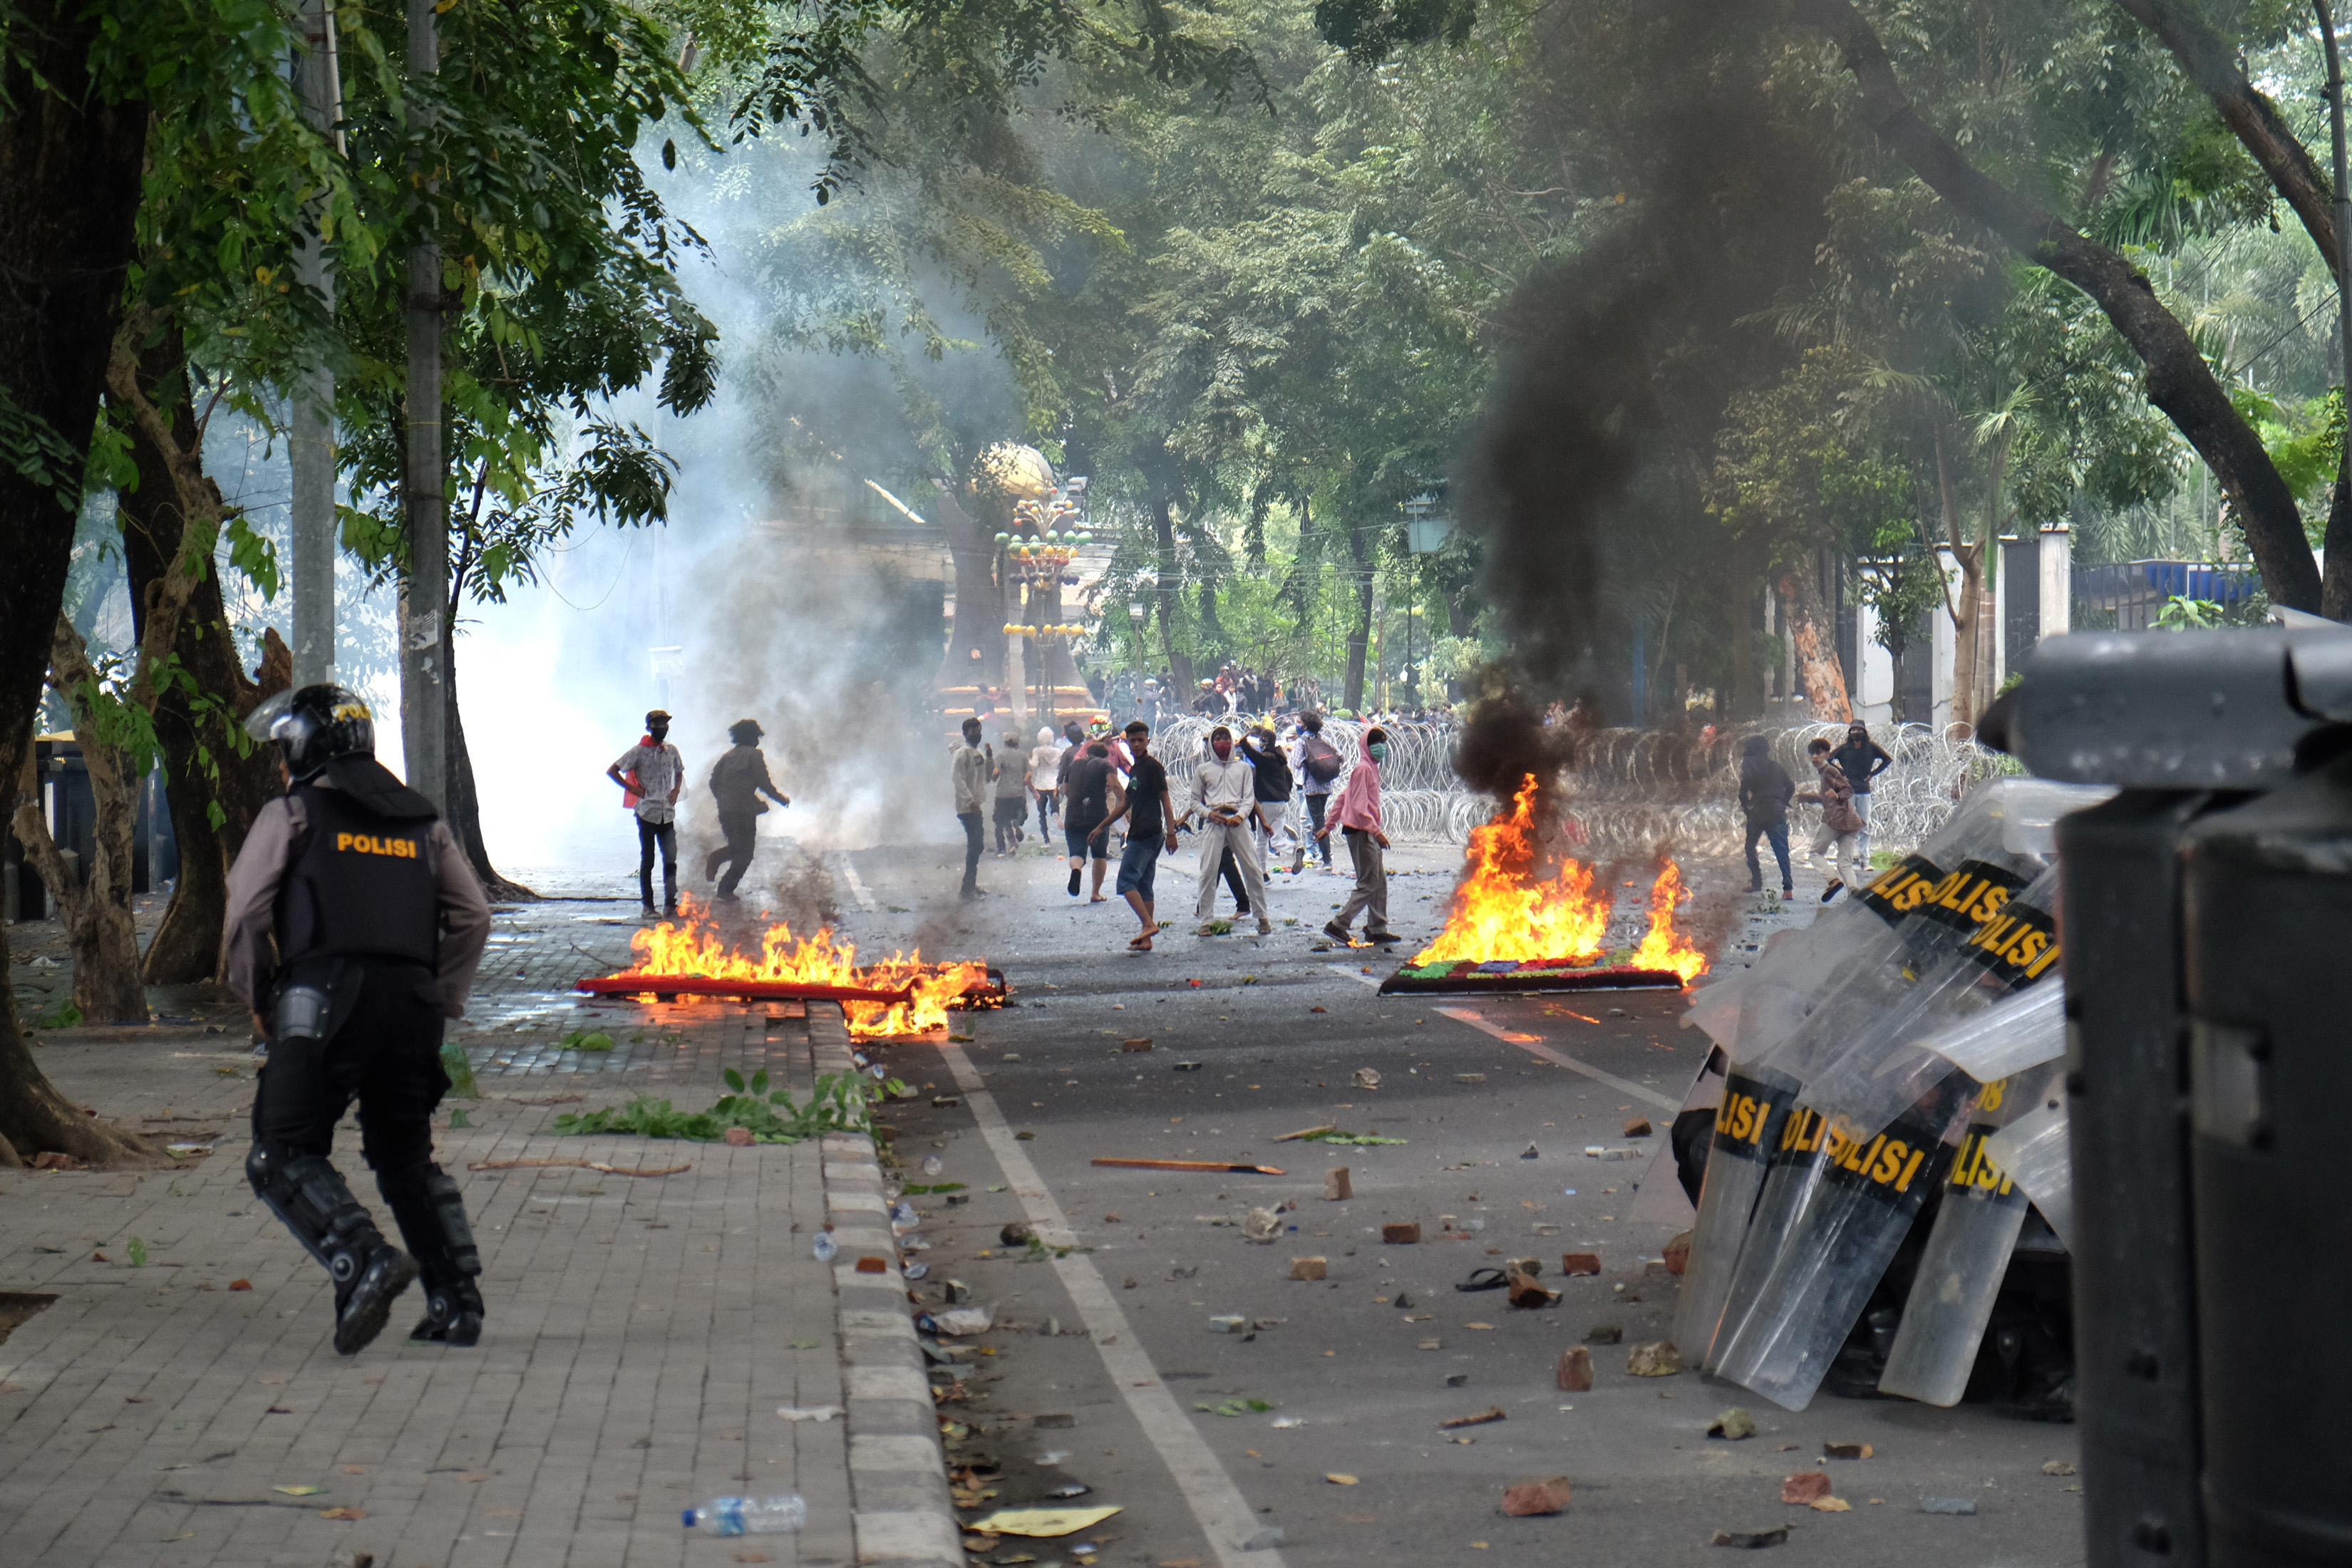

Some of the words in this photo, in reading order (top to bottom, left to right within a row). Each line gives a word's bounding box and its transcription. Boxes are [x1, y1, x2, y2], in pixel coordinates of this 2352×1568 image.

[337, 832, 416, 858] POLISI
[1865, 865, 1933, 911] LIS
[1927, 871, 2008, 922] OLIS
[1971, 914, 2062, 979] OLISI
[1716, 1090, 1771, 1145] LISI
[1783, 1108, 1850, 1156] OLIS
[1834, 1125, 1925, 1192] OLISI
